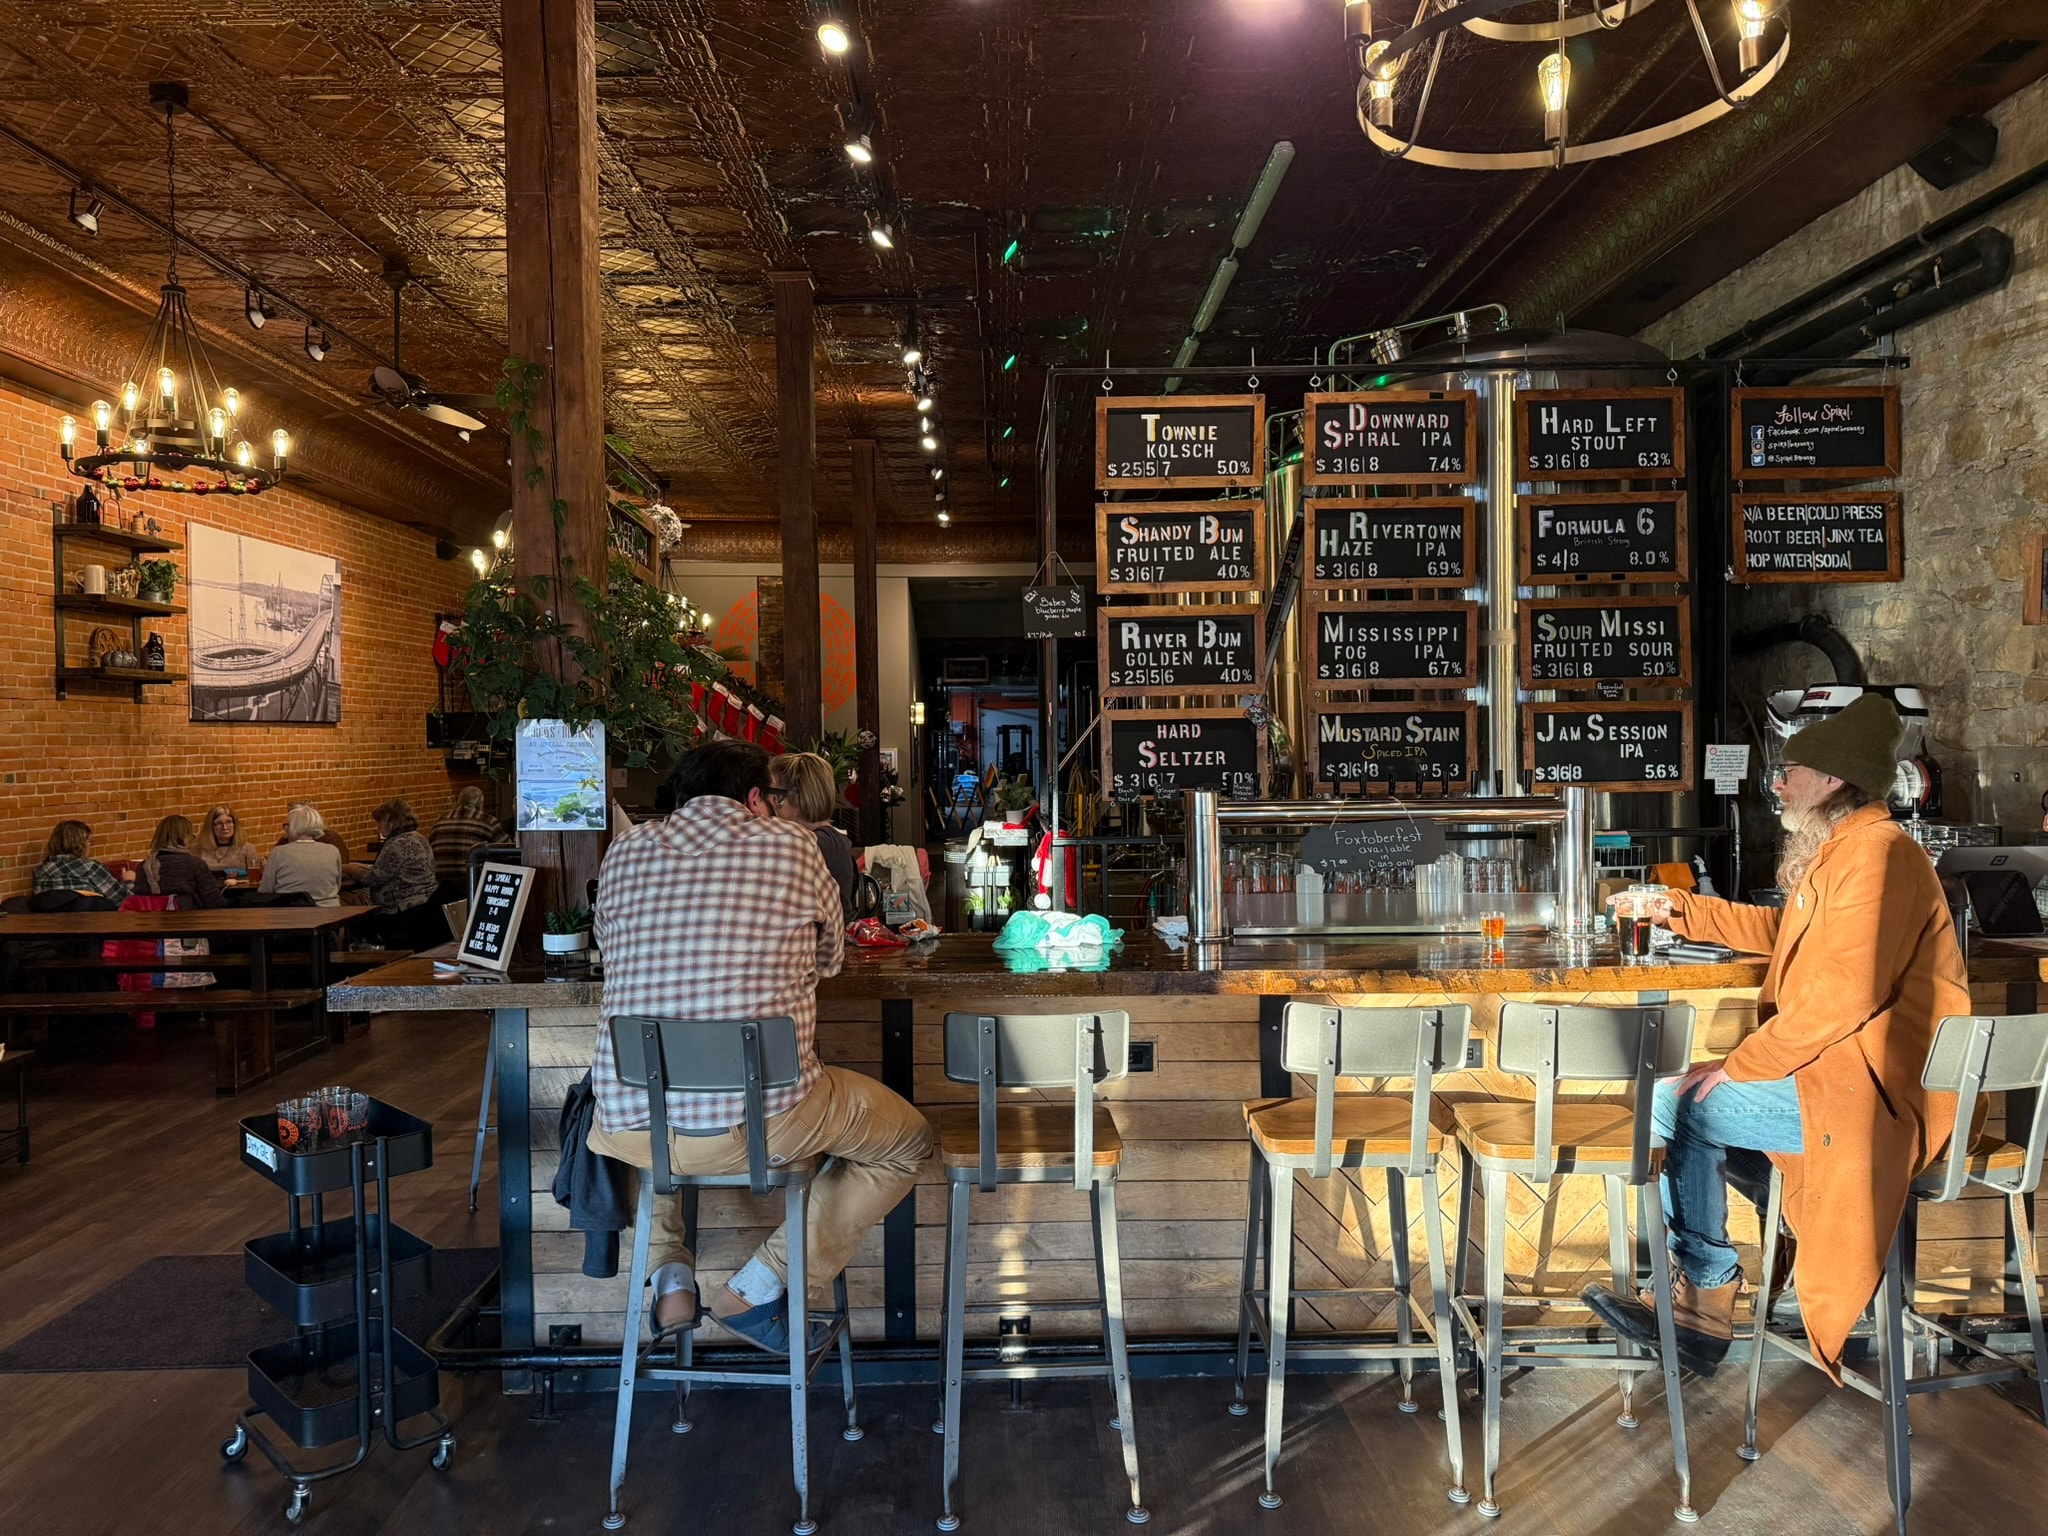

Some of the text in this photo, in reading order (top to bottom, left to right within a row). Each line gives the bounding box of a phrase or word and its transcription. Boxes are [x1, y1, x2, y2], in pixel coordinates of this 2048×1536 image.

[1349, 404, 1449, 431] DOWNWARD
[1541, 406, 1657, 434] HARD LEFT
[1141, 414, 1218, 441] TOWNIE
[1323, 420, 1452, 449] SPIRAL IPA
[1147, 444, 1214, 458] KOLSCH
[1572, 436, 1626, 450] STOUT
[1843, 506, 1882, 520] PRESS
[1121, 515, 1243, 545] SHANDY BUM
[1349, 512, 1461, 539] RIVERTOWN
[1538, 507, 1655, 538] FORMULA 6
[1320, 529, 1446, 557] HAZE IPA
[1745, 529, 1781, 544] ROOT
[1858, 529, 1883, 543] TEA
[1117, 546, 1241, 563] FRUITED ALE
[1746, 553, 1770, 567] HOP
[1121, 620, 1241, 649] RIVER BUM
[1324, 615, 1457, 643] MISSISSIPPI
[1538, 610, 1664, 642] SOUR MISSI
[1126, 651, 1235, 666] GOLDEN ALE
[1334, 644, 1444, 660] FOG IPA
[1534, 642, 1673, 658] FRUITED SOUR
[1158, 724, 1201, 739] HARD
[1321, 715, 1459, 743] MUSTARD STAIN
[1537, 714, 1667, 742] JAM SESSION
[1138, 740, 1226, 768] SELTZER
[1620, 744, 1644, 758] IPA
[1335, 826, 1423, 845] Foxtoberfest
[1359, 844, 1412, 854] available
[1397, 858, 1414, 867] only
[495, 873, 511, 883] SPIRAL
[484, 884, 499, 894] HAPPY
